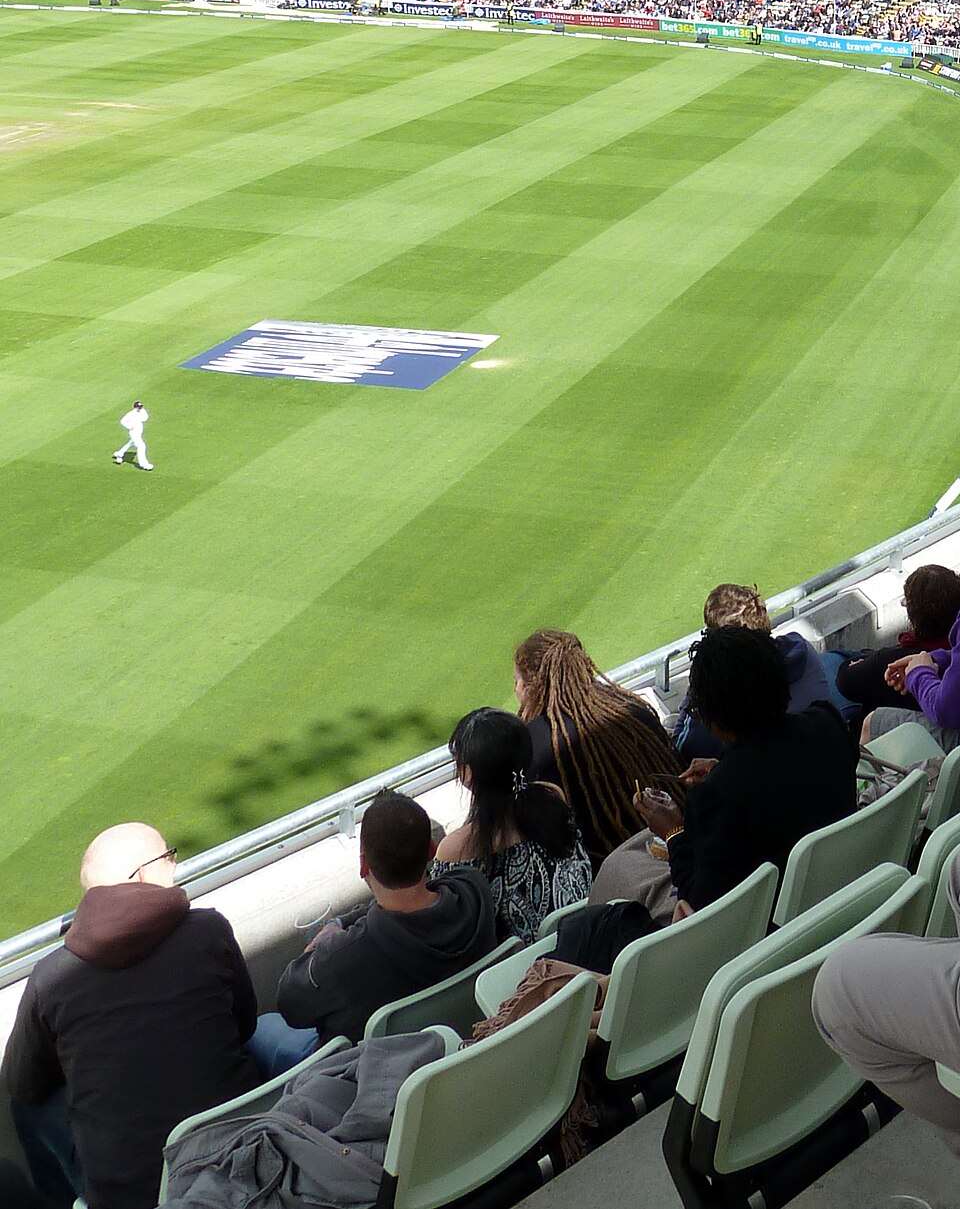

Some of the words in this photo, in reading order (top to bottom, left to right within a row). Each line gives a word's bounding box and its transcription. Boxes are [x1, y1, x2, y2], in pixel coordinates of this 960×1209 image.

[485, 7, 536, 21] Invstec
[580, 15, 614, 23] Laithwaite's
[620, 18, 654, 26] Laithwaite's
[661, 21, 718, 36] bet365.com
[722, 26, 780, 42] bet36com
